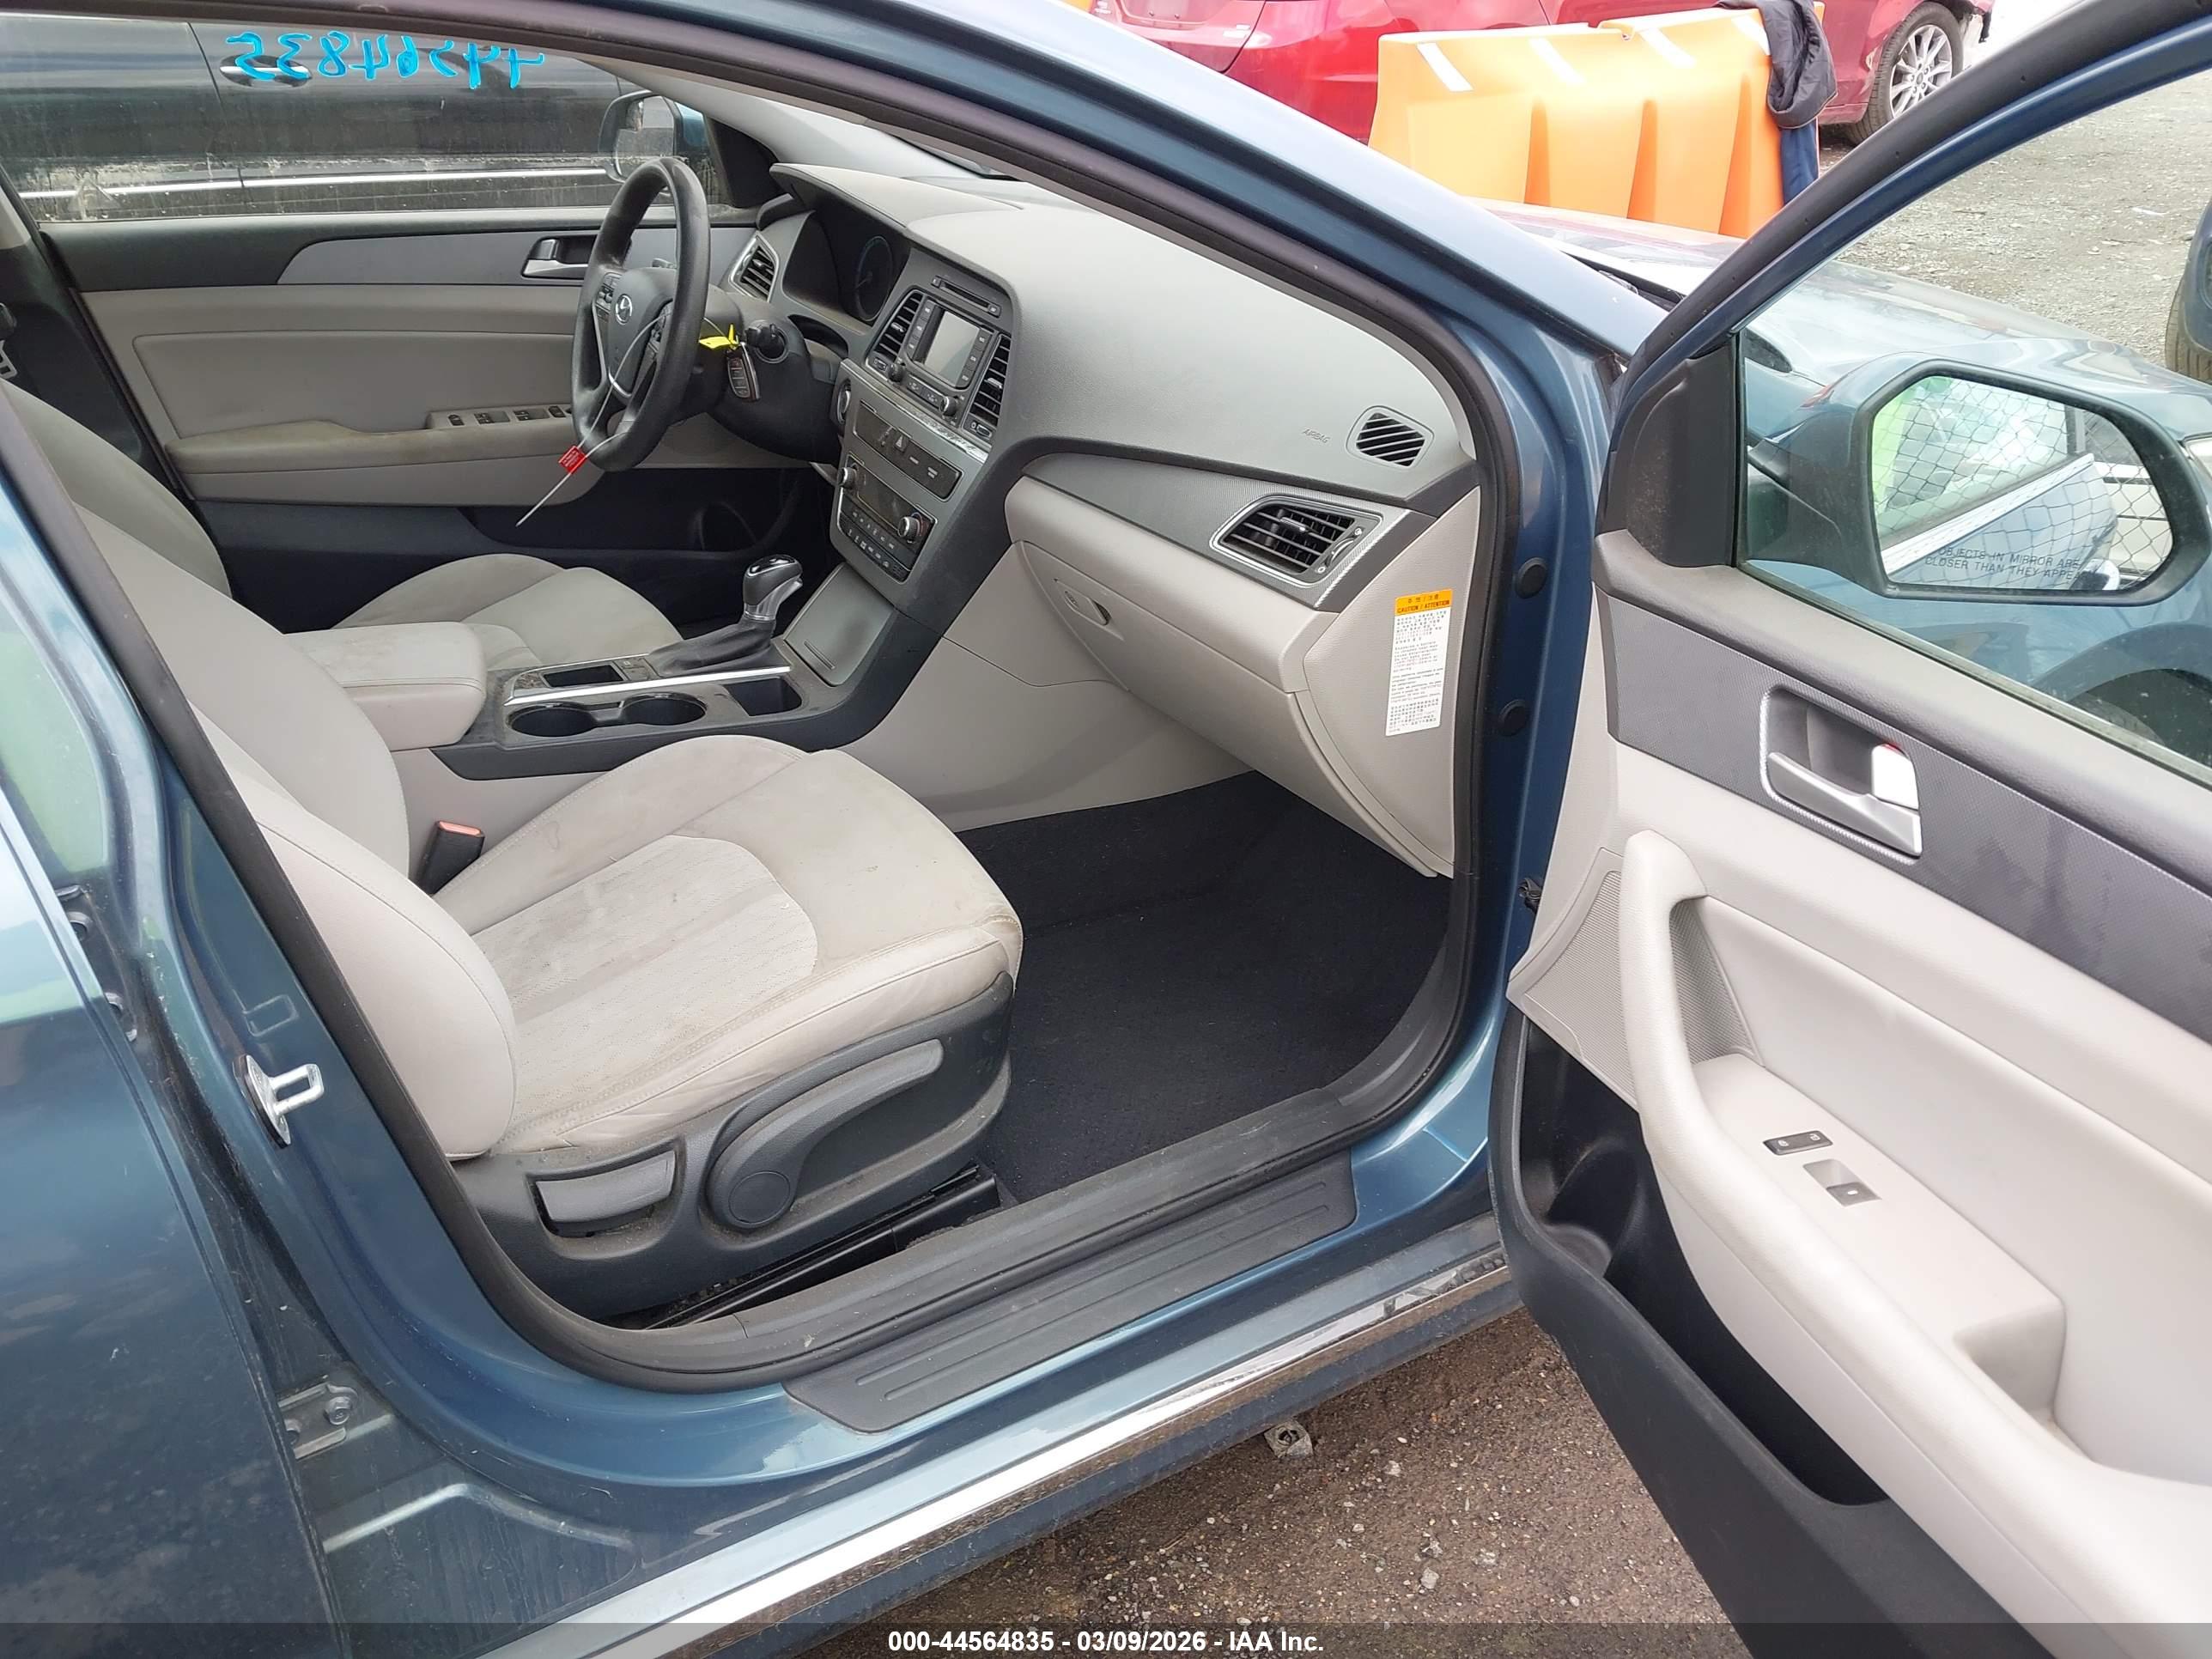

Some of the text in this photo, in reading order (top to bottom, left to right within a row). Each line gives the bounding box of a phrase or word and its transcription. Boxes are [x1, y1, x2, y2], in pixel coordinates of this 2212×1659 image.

[1924, 556, 1969, 569] CLOSER
[1975, 562, 2005, 573] THAN
[2009, 565, 2040, 576] THEY
[1938, 547, 2080, 568] OBJECTS IN MIRROR ARE
